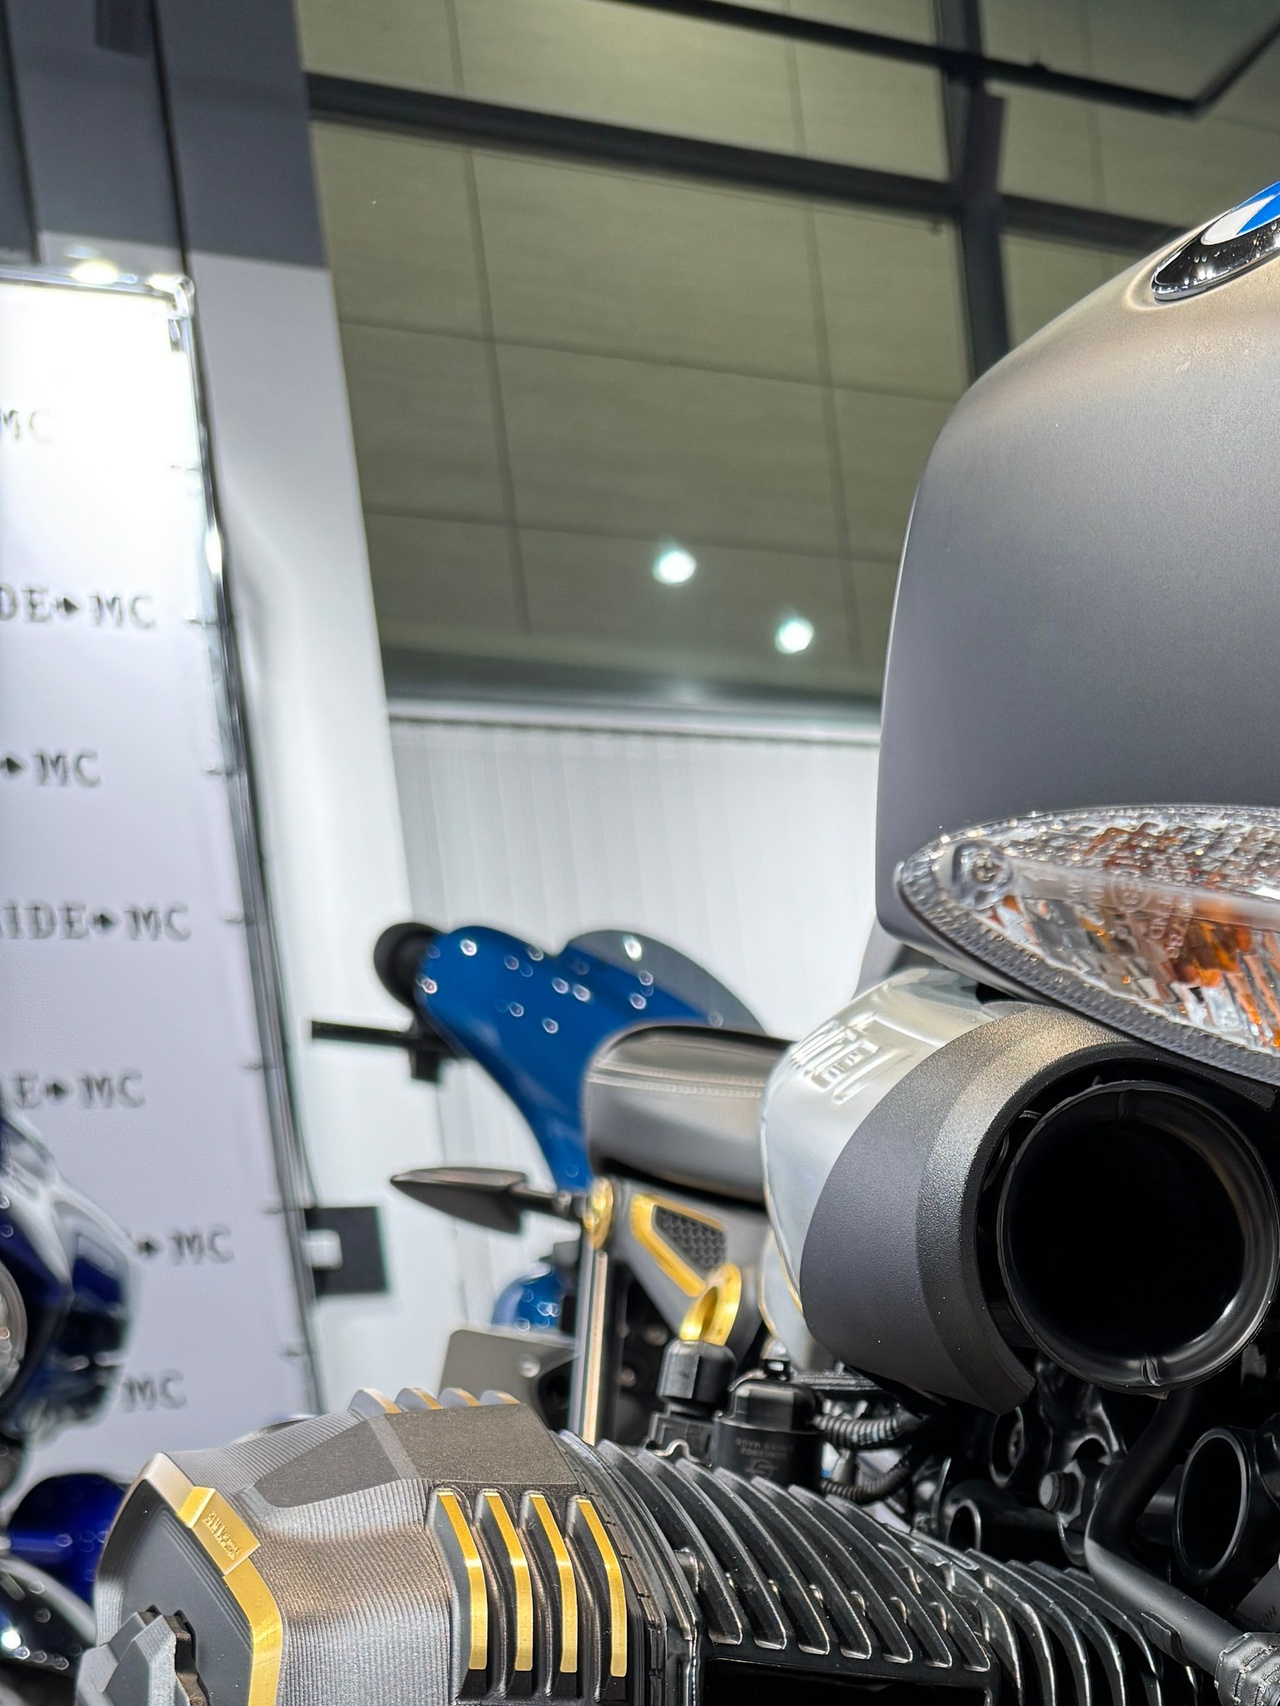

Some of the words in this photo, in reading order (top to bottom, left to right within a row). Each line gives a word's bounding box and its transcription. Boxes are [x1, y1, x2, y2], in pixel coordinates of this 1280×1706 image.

[90, 594, 155, 629] MC
[33, 752, 100, 787] MC
[0, 902, 88, 939] IDE
[124, 903, 192, 941] MC
[80, 1069, 146, 1109] MC
[169, 1226, 234, 1264] MC
[122, 1371, 188, 1411] MC
